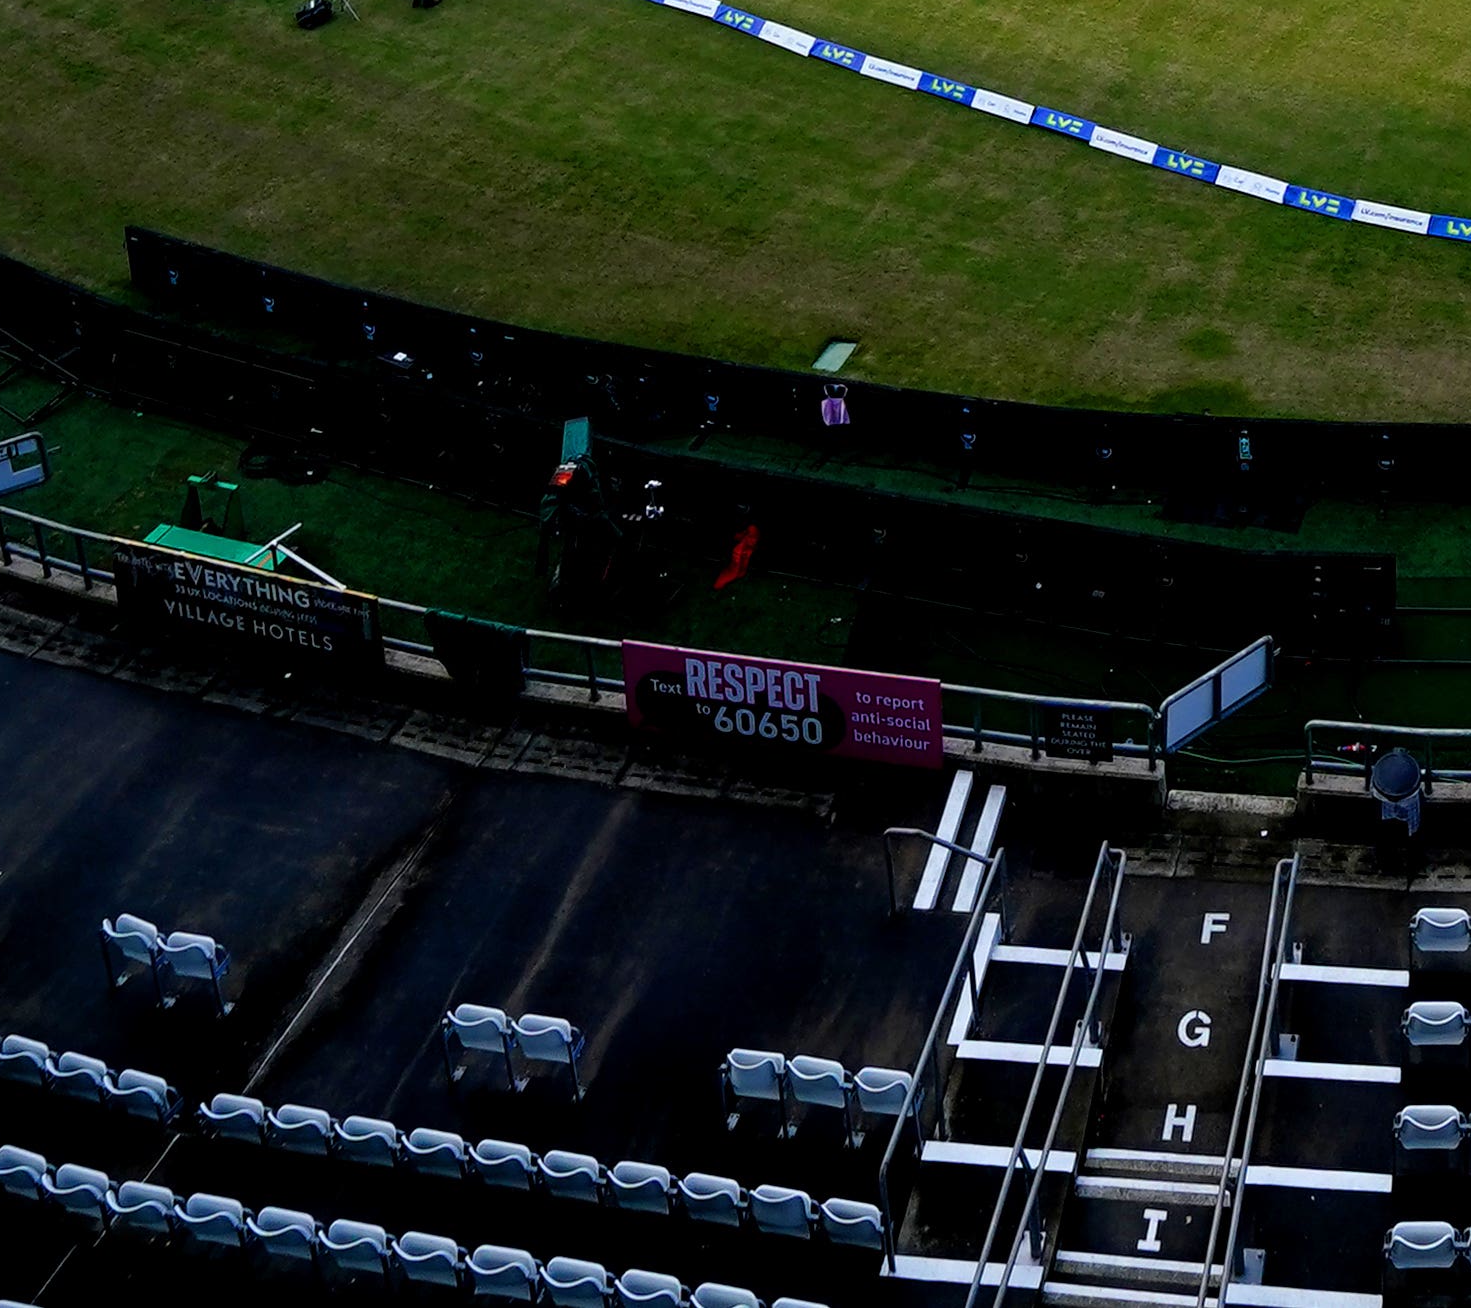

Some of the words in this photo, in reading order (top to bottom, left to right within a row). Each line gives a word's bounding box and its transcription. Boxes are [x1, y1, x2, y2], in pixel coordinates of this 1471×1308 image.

[174, 561, 309, 608] EVERYTHING
[164, 599, 245, 631] VILLAGE
[253, 620, 333, 651] HOTELS
[649, 677, 682, 696] Text
[685, 658, 821, 713] RESPECT
[855, 690, 871, 705] to
[875, 693, 924, 713] report
[695, 702, 711, 716] to
[714, 708, 823, 745] 60650
[850, 709, 931, 732] anti-social
[852, 729, 930, 752] behaviour
[1200, 912, 1229, 944] F
[1177, 1010, 1212, 1048] G
[1161, 1103, 1197, 1143] H
[1137, 1208, 1168, 1252] I
